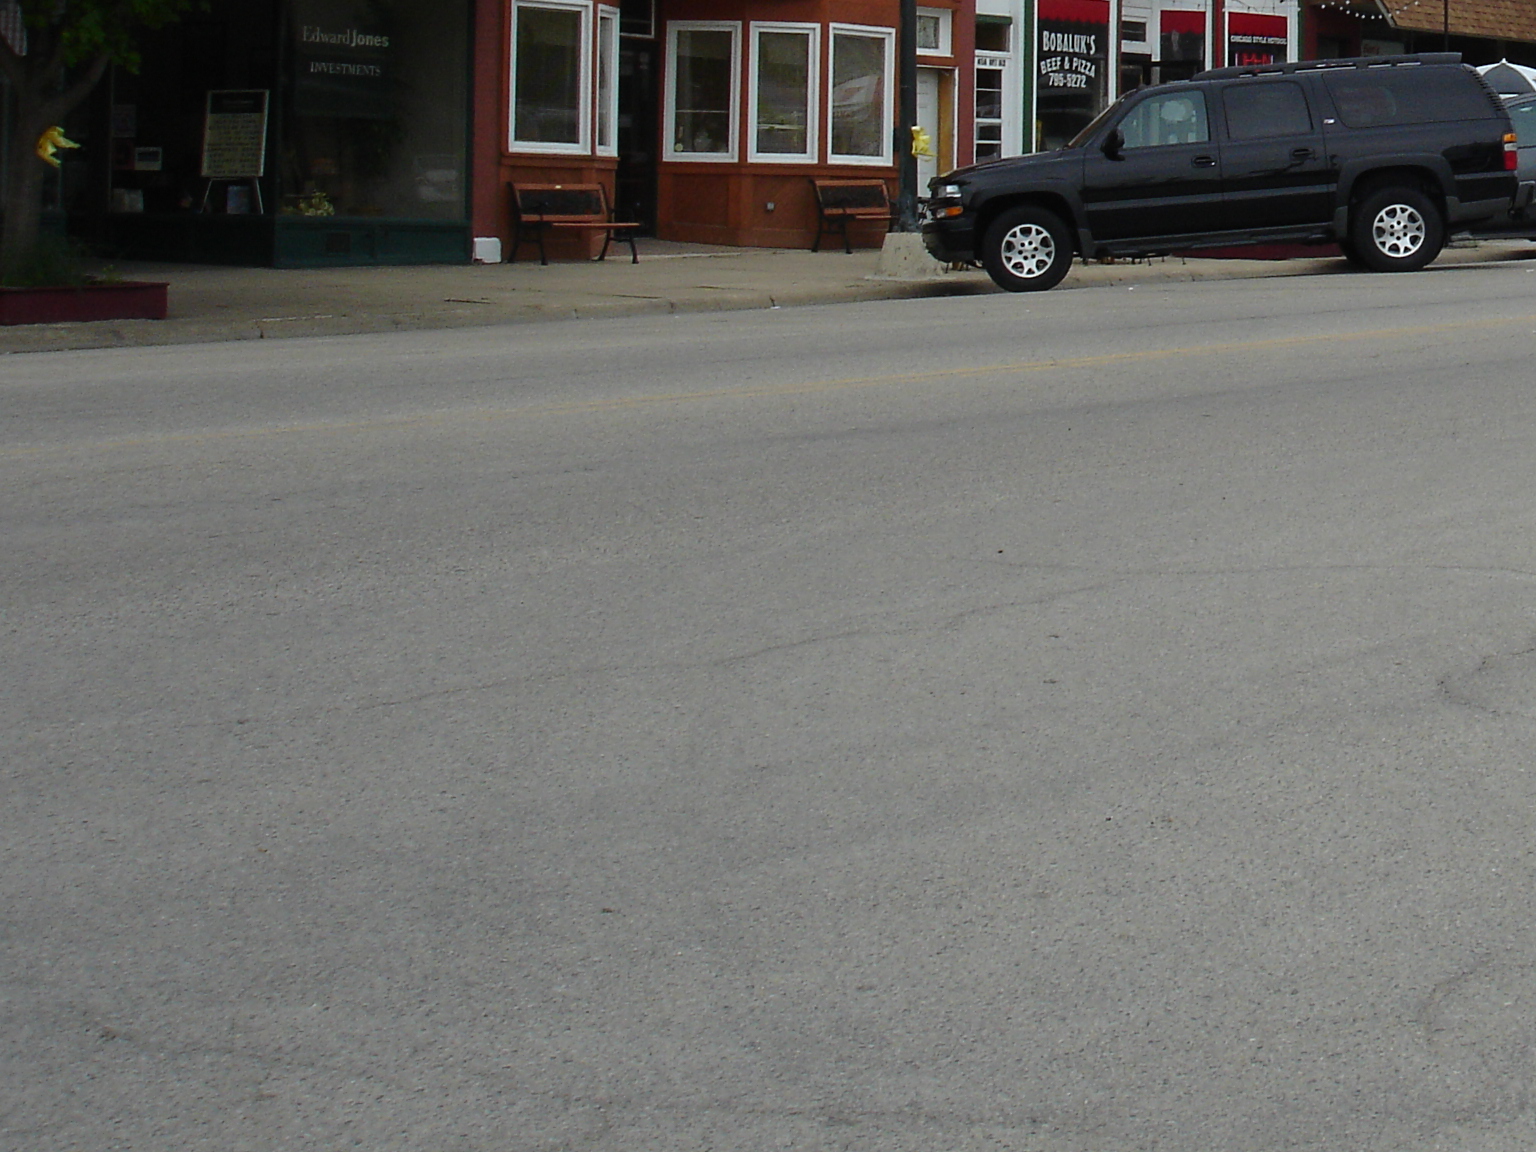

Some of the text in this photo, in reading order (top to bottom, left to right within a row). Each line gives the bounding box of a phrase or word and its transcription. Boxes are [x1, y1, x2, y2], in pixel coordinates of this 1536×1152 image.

[1042, 30, 1096, 55] BOBALUK'S
[309, 61, 381, 77] INVESTMENTS
[1040, 56, 1096, 78] BEEF & PIZZA
